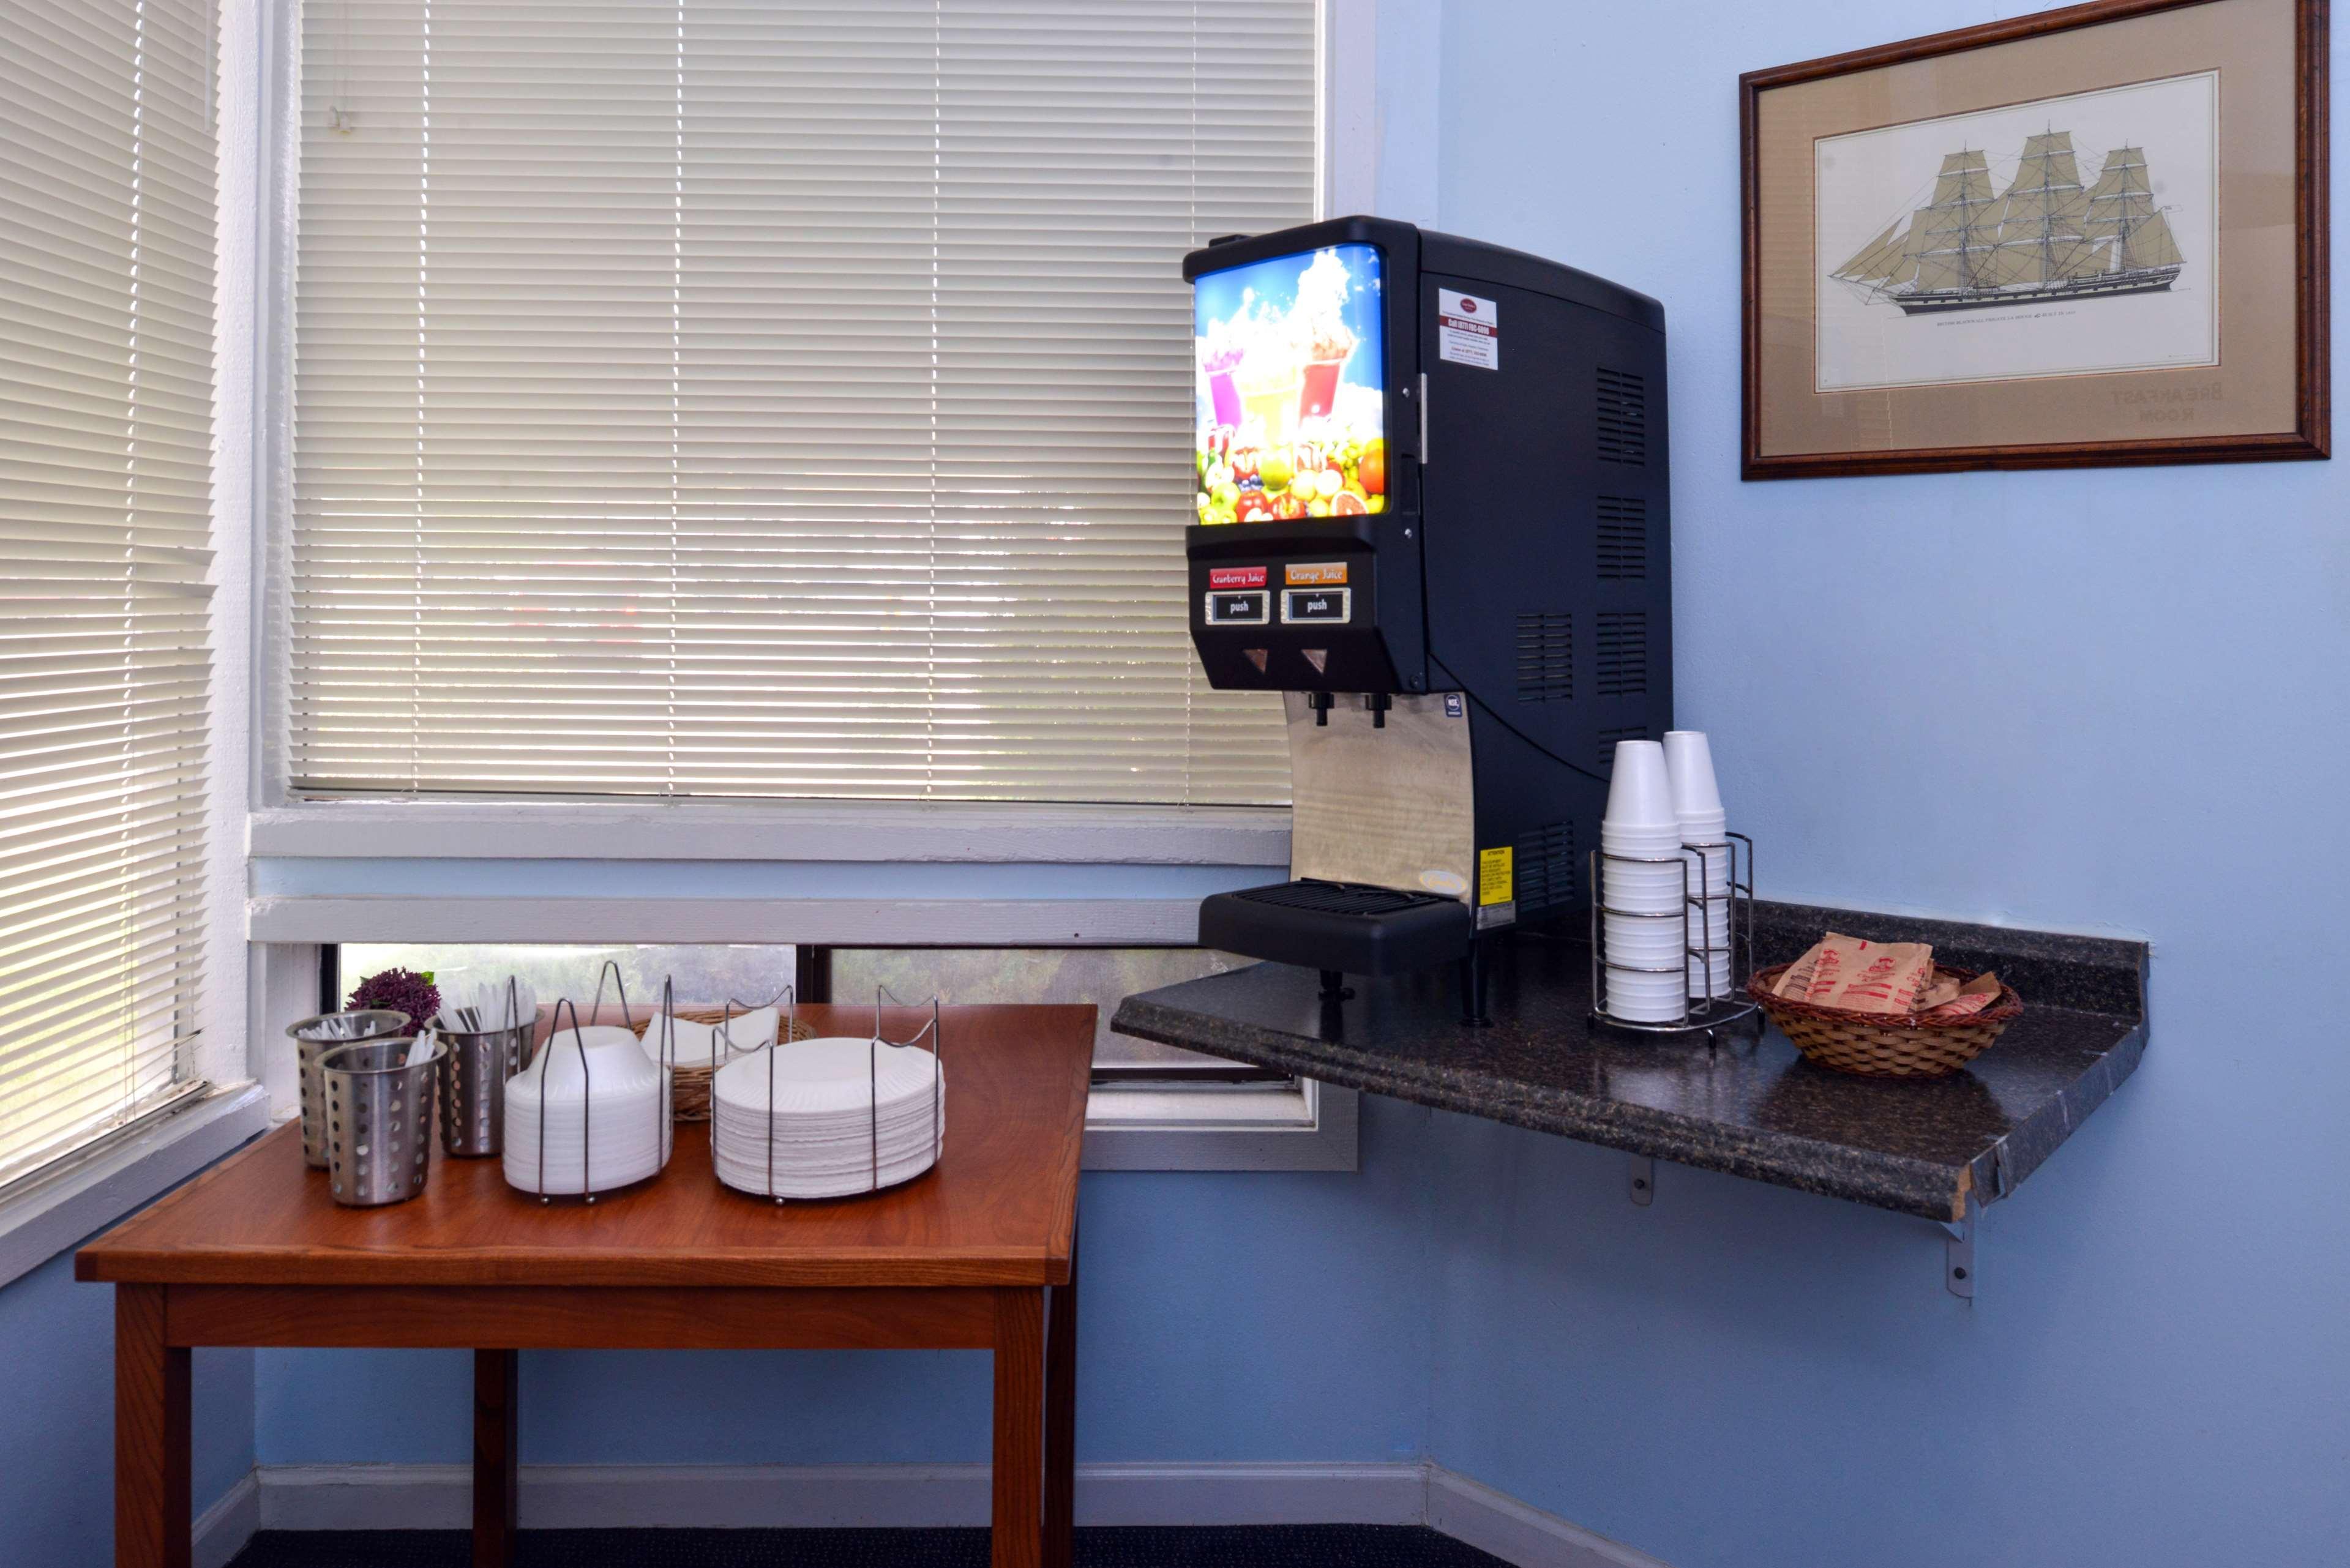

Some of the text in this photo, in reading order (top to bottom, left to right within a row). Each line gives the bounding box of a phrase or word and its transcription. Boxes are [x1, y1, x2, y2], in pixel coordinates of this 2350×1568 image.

[1212, 571, 1265, 584] Cranberry Juice
[1290, 567, 1343, 584] Orange Juice
[1230, 600, 1249, 614] push
[1307, 599, 1327, 613] push
